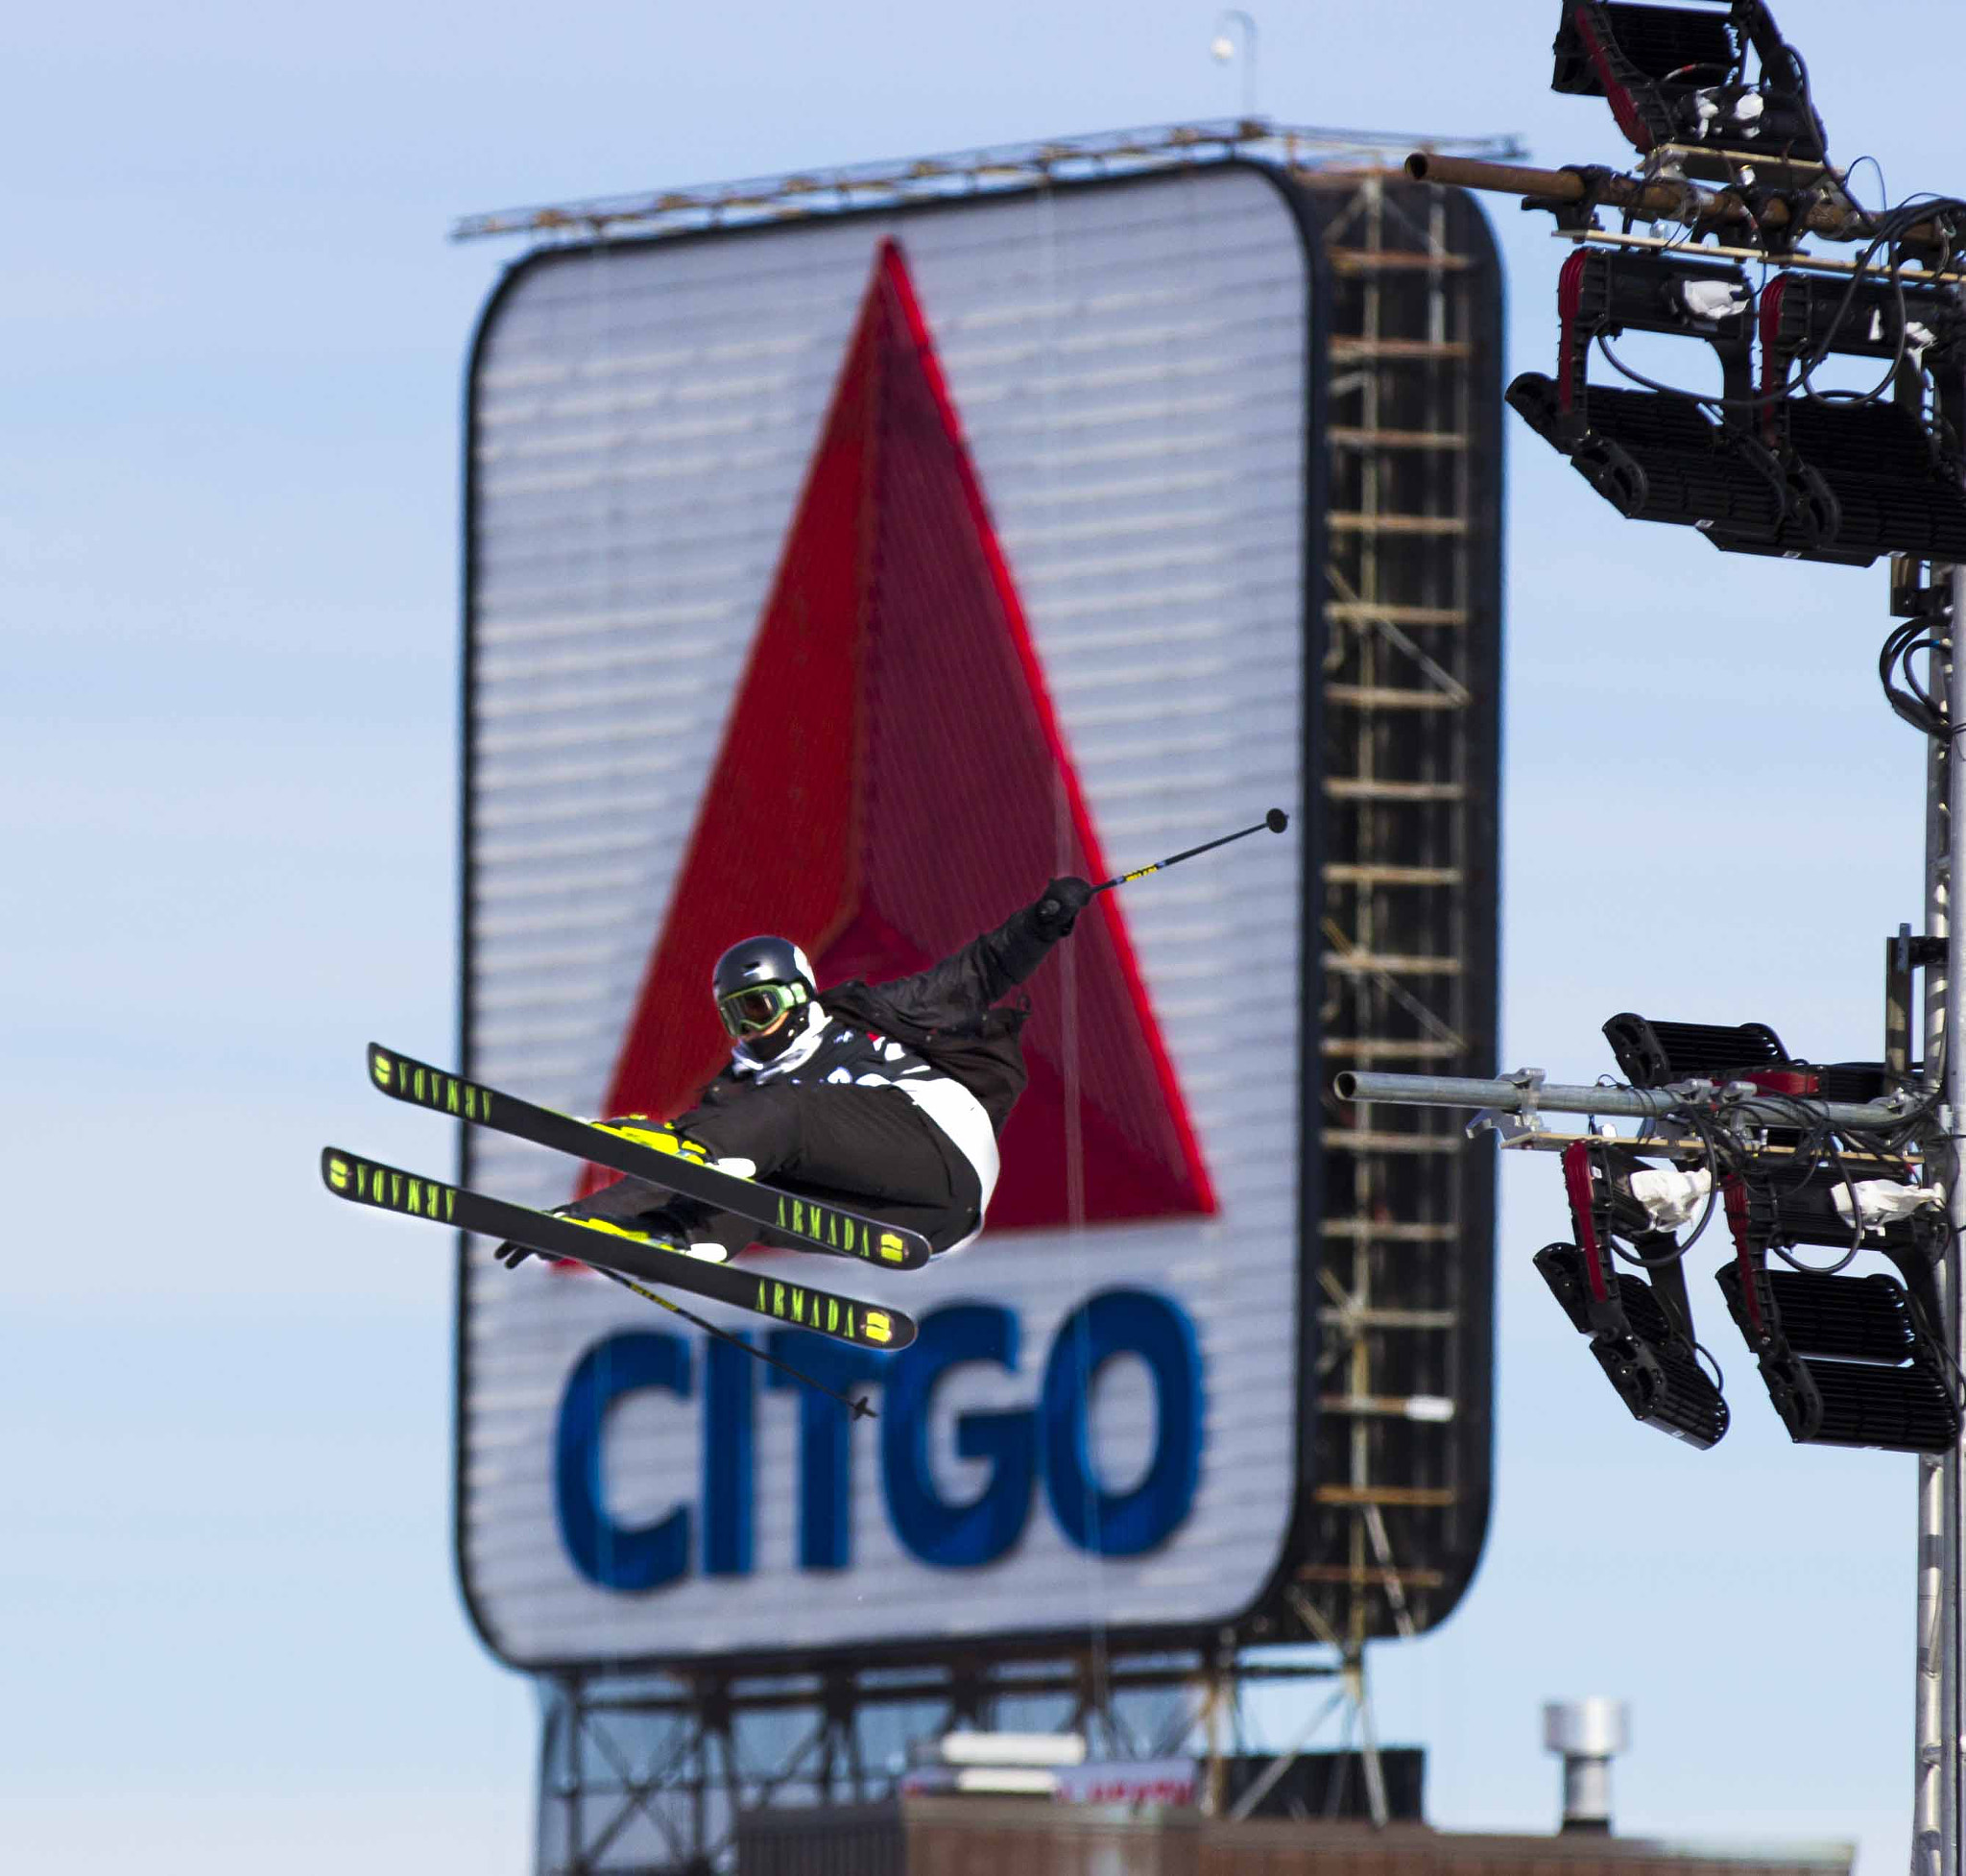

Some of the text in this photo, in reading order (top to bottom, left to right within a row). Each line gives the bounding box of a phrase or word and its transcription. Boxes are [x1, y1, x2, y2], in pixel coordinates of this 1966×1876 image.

[776, 1195, 871, 1258] ARMADA
[755, 1279, 855, 1338] ARMADA
[554, 1287, 1207, 1596] CITGO
